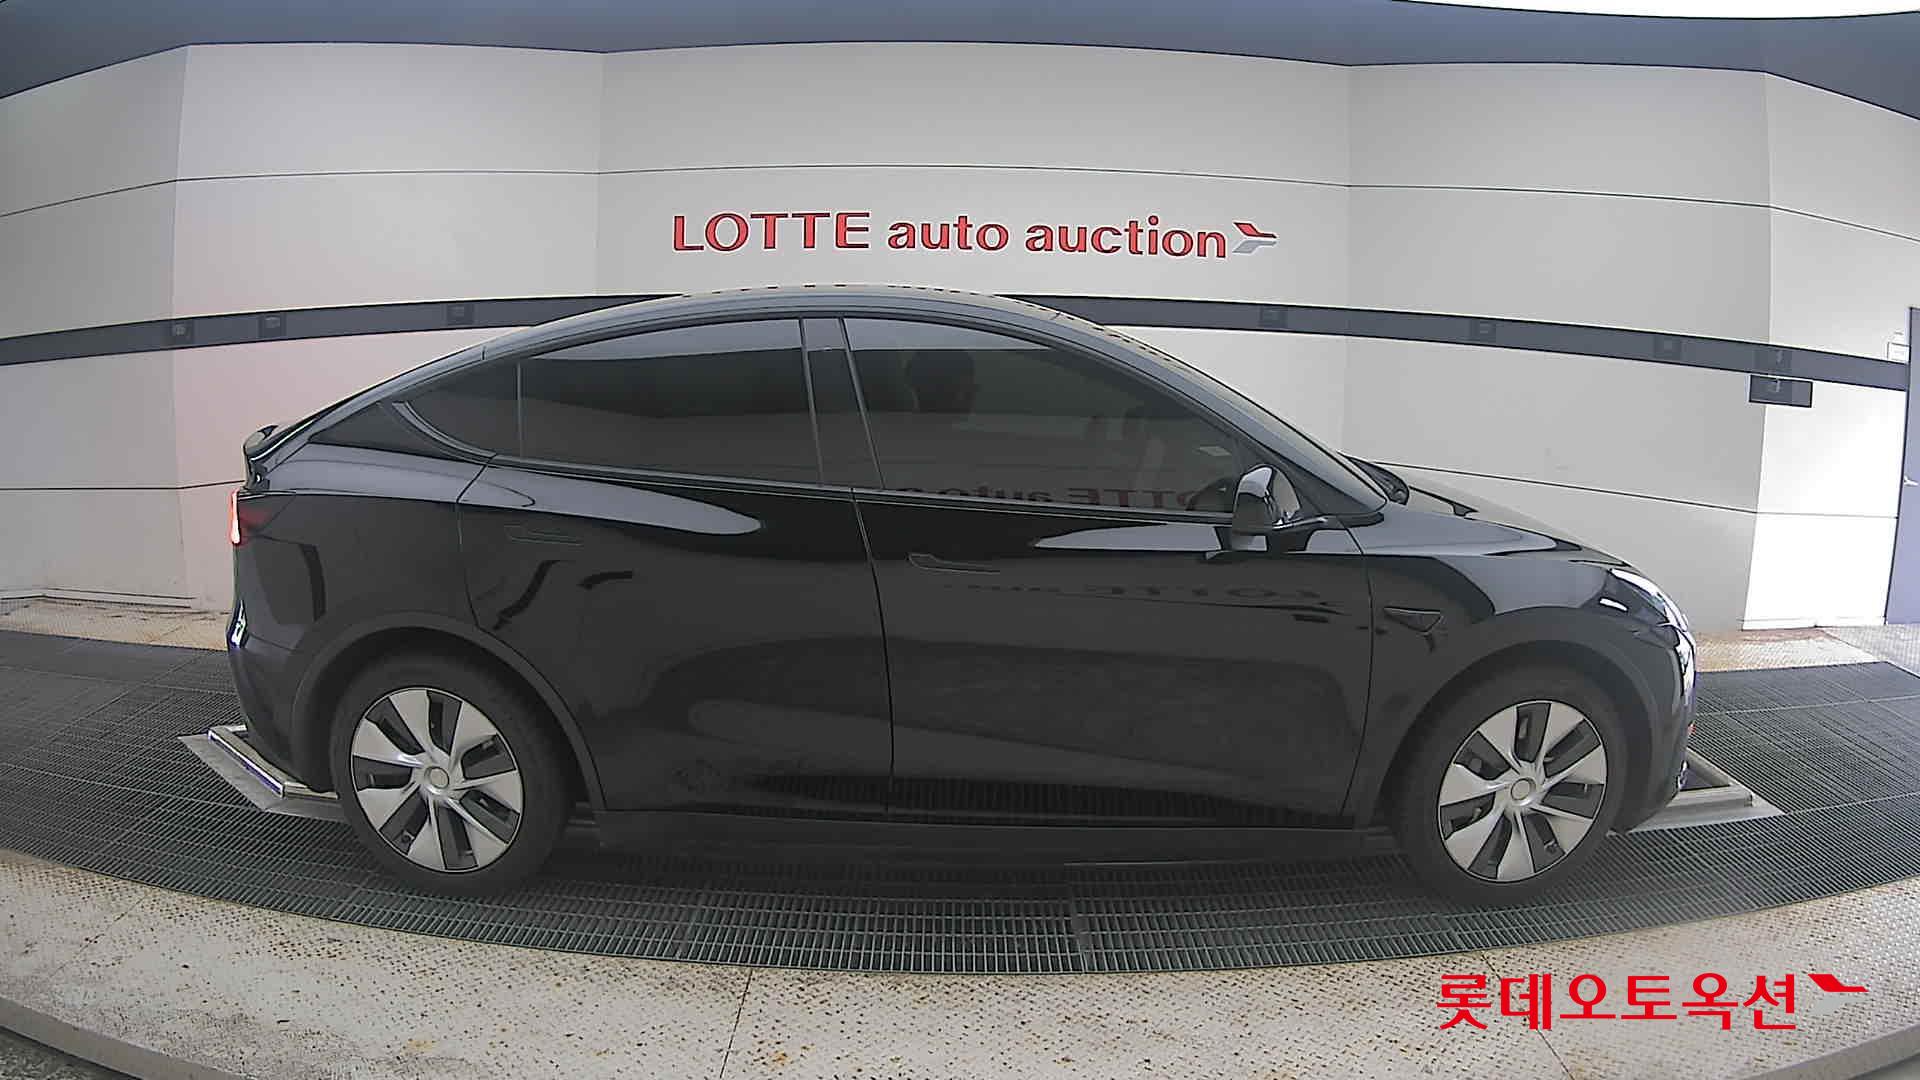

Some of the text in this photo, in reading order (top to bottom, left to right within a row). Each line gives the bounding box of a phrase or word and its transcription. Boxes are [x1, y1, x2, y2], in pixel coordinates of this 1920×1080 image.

[673, 213, 1227, 258] LOTTE auto auction
